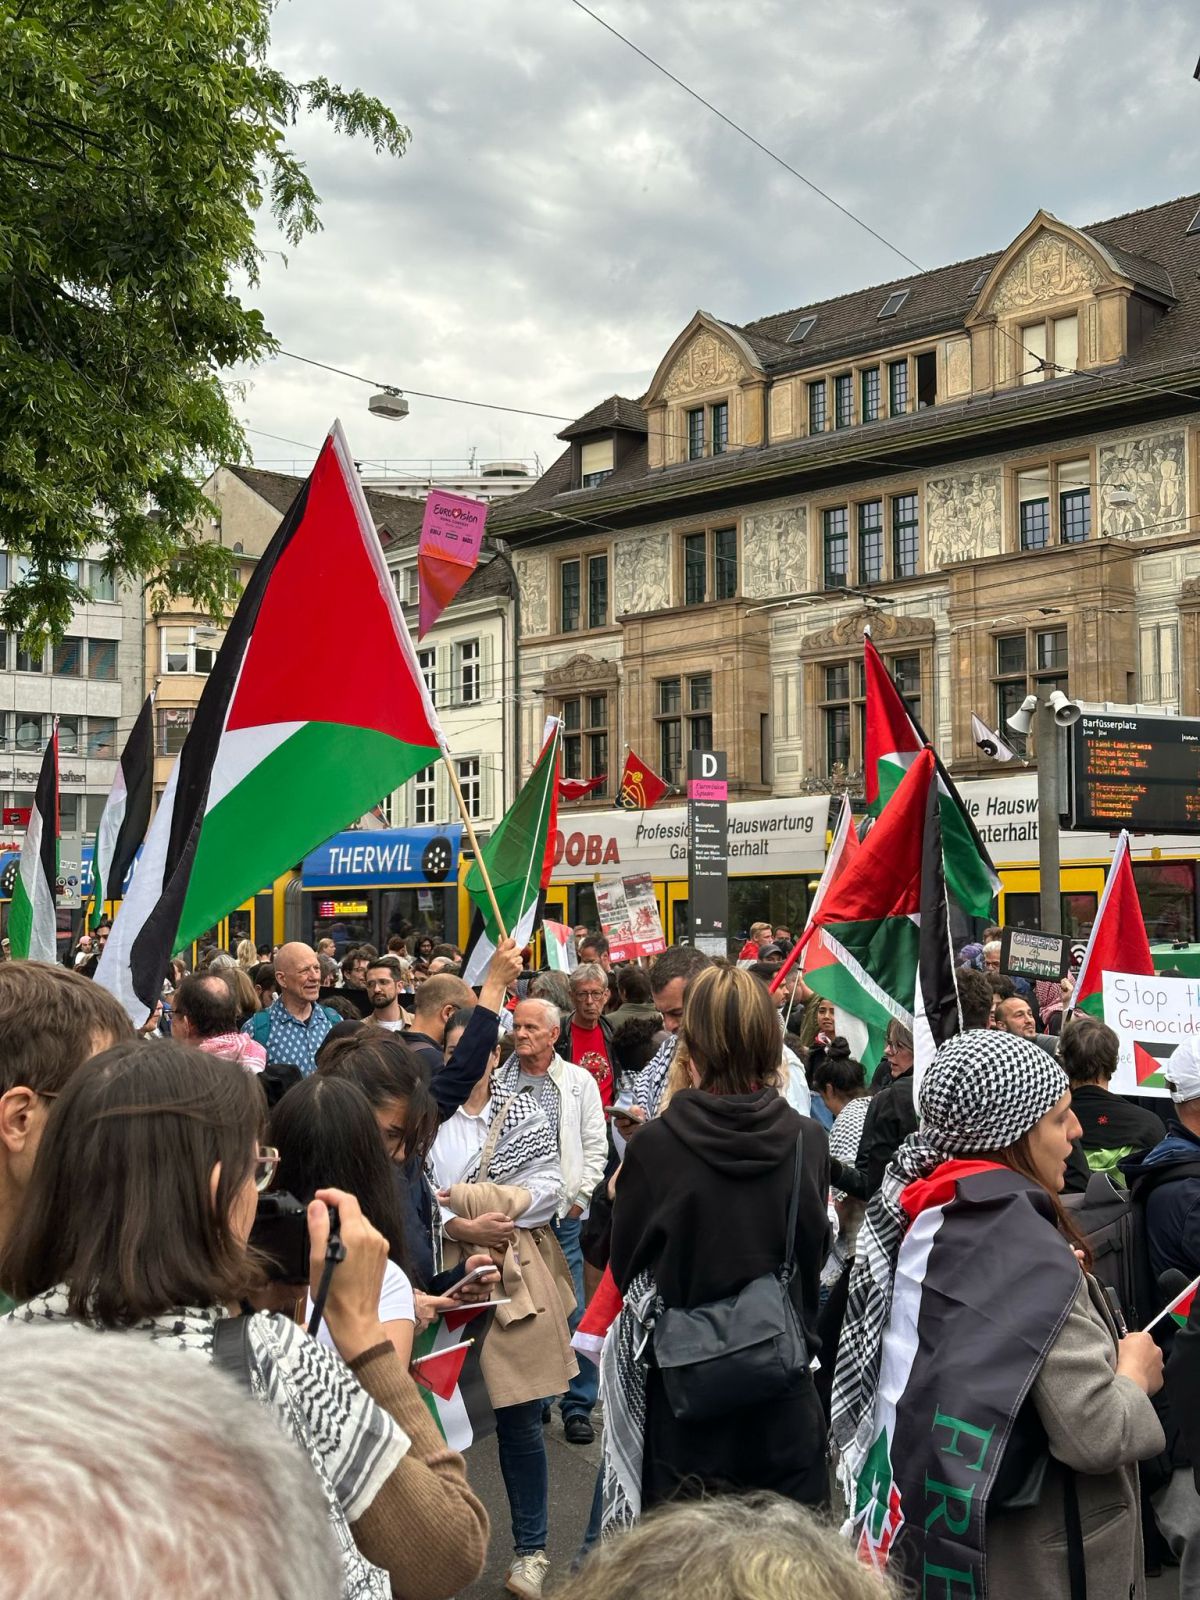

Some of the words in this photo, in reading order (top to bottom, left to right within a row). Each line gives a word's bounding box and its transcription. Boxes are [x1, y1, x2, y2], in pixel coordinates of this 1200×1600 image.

[1083, 719, 1137, 730] Barfüsserplatz
[702, 754, 718, 778] D
[986, 797, 1038, 816] Hausw
[728, 814, 814, 835] Hauswartung
[979, 821, 1038, 842] nterhalt
[329, 844, 412, 874] THERWIL
[1029, 948, 1040, 960] 4
[1115, 979, 1167, 1012] Stop
